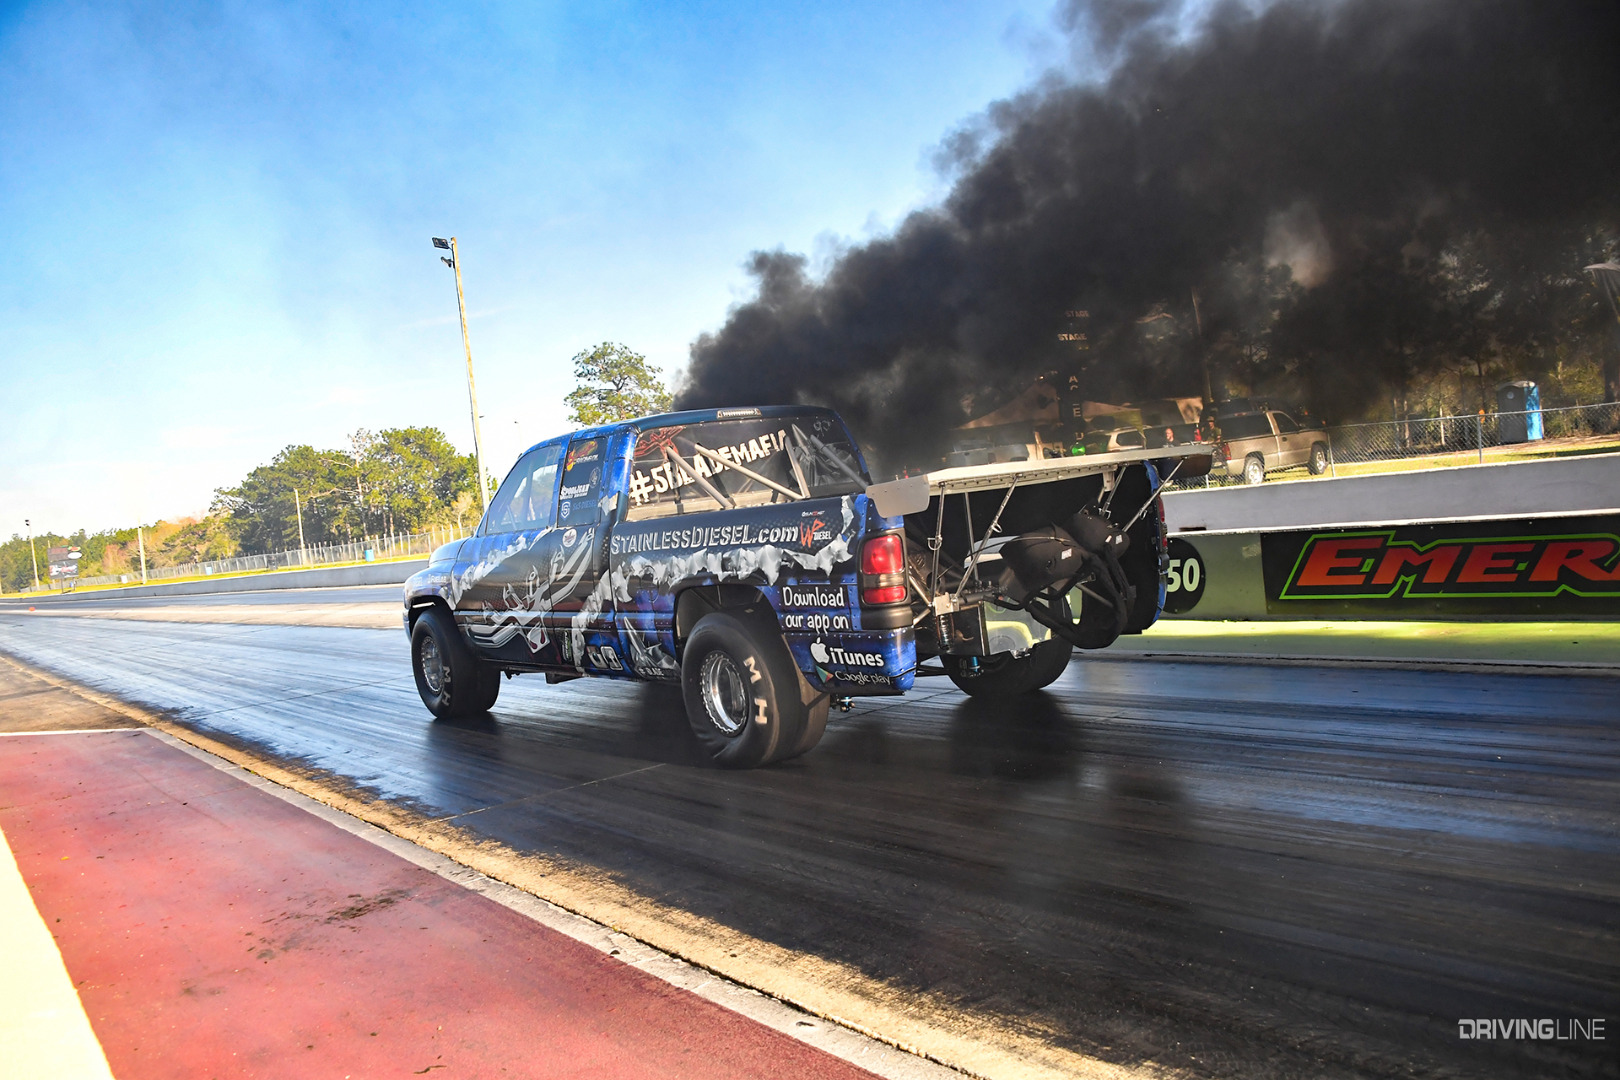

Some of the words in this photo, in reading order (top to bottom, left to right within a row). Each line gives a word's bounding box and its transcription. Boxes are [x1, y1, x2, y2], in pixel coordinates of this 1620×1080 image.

[610, 523, 799, 555] STAINLESSDIESEL.com
[813, 531, 832, 541] DIESEL
[1297, 537, 1620, 586] EMER
[782, 586, 845, 607] Download
[785, 614, 804, 628] our
[807, 614, 830, 635] app
[833, 614, 849, 629] on
[829, 647, 885, 667] iTunes
